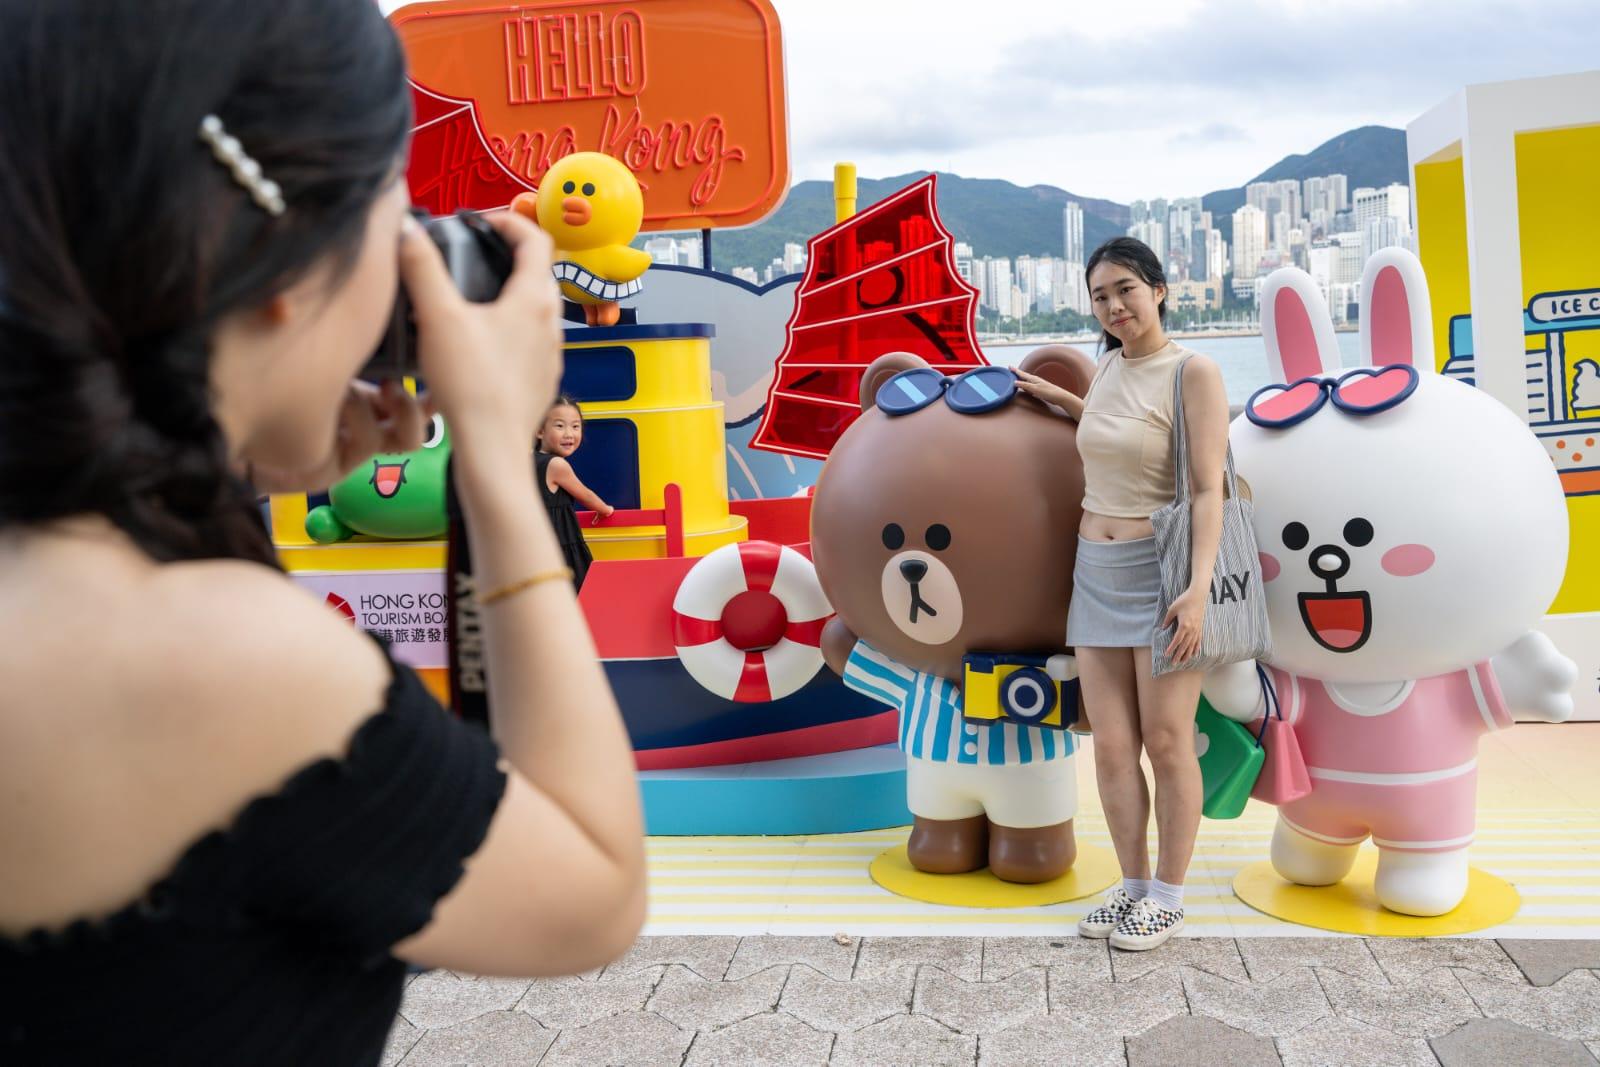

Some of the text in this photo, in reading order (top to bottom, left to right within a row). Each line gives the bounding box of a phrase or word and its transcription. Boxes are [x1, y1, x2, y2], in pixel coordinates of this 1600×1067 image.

[504, 9, 646, 105] HELLO
[1551, 298, 1582, 315] ICE
[360, 593, 414, 610] HONG
[361, 612, 421, 625] TOURISM
